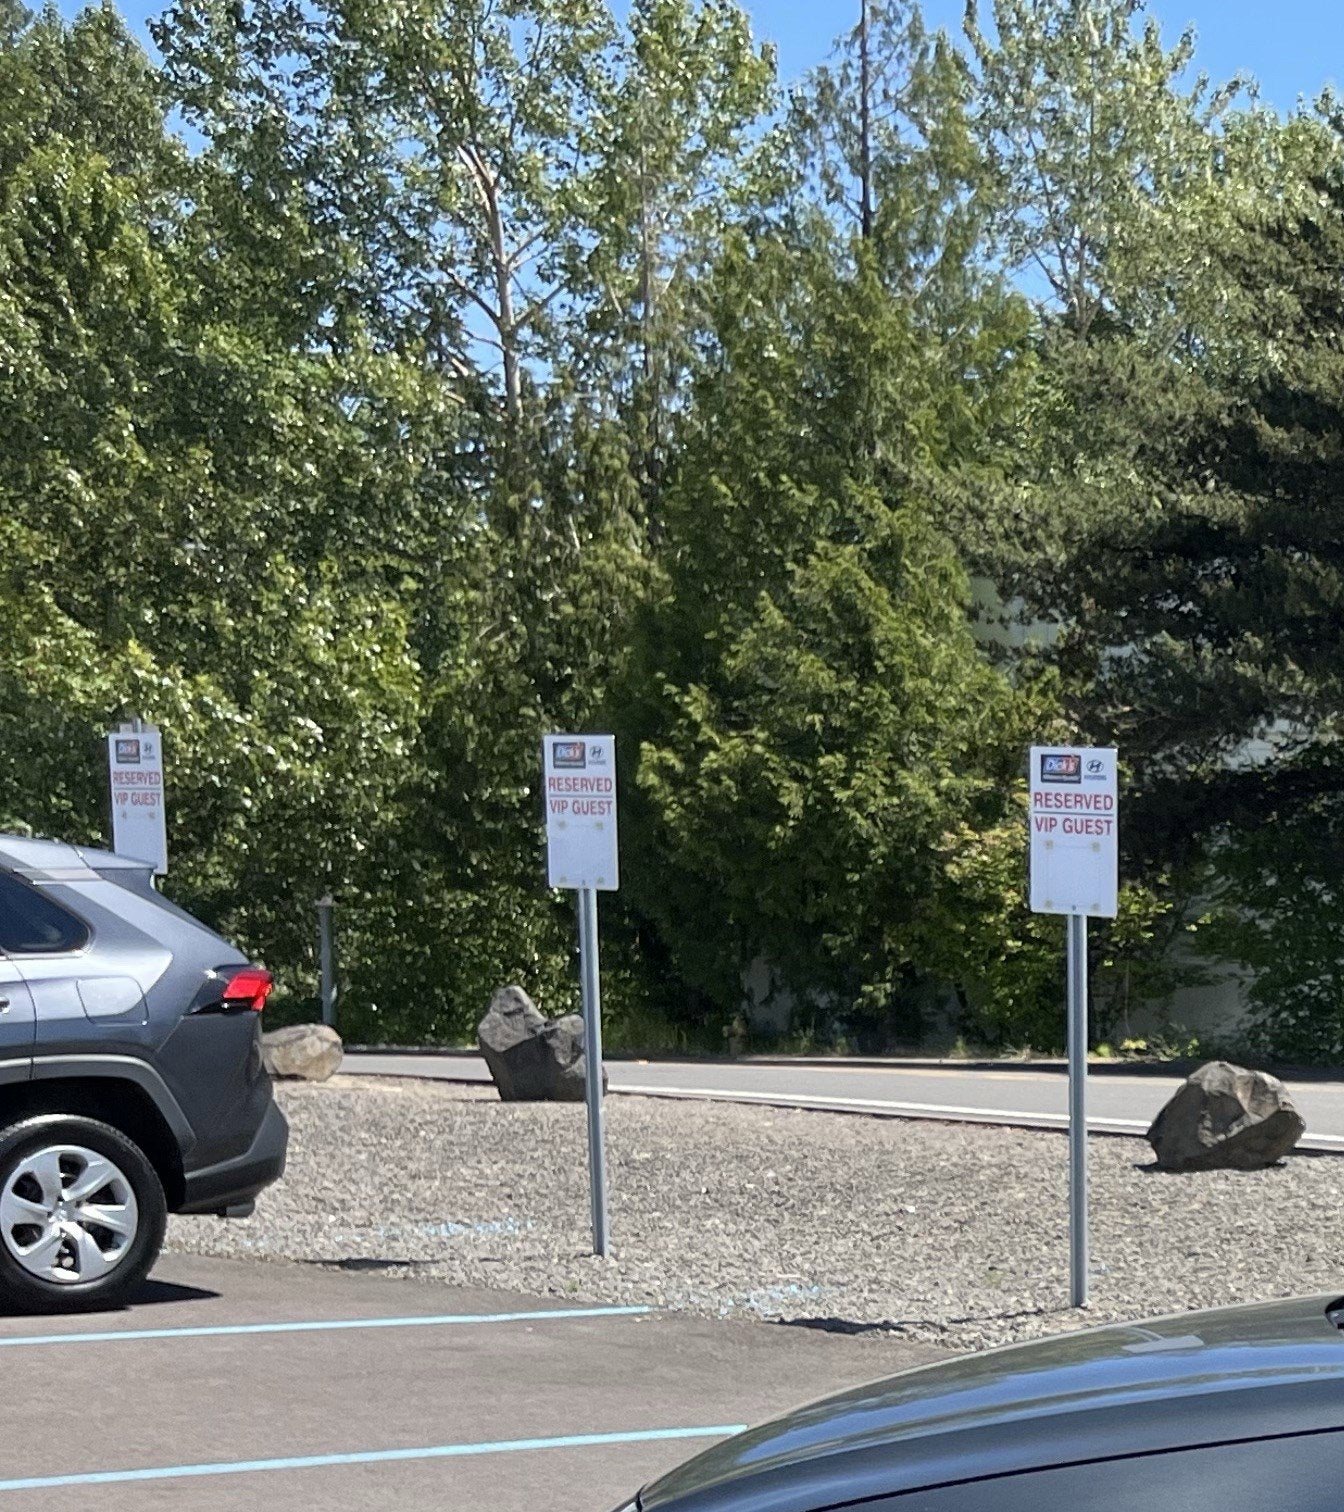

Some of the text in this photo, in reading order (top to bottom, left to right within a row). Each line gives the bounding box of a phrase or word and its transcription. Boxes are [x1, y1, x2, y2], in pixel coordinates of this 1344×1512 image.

[113, 771, 161, 785] RESERVED
[548, 776, 613, 792] RESERVED
[114, 792, 161, 806] VIP GUEST
[1034, 791, 1114, 811] RESERVED
[550, 800, 613, 815] VIP GUEST
[1035, 816, 1114, 836] VIP GUEST
